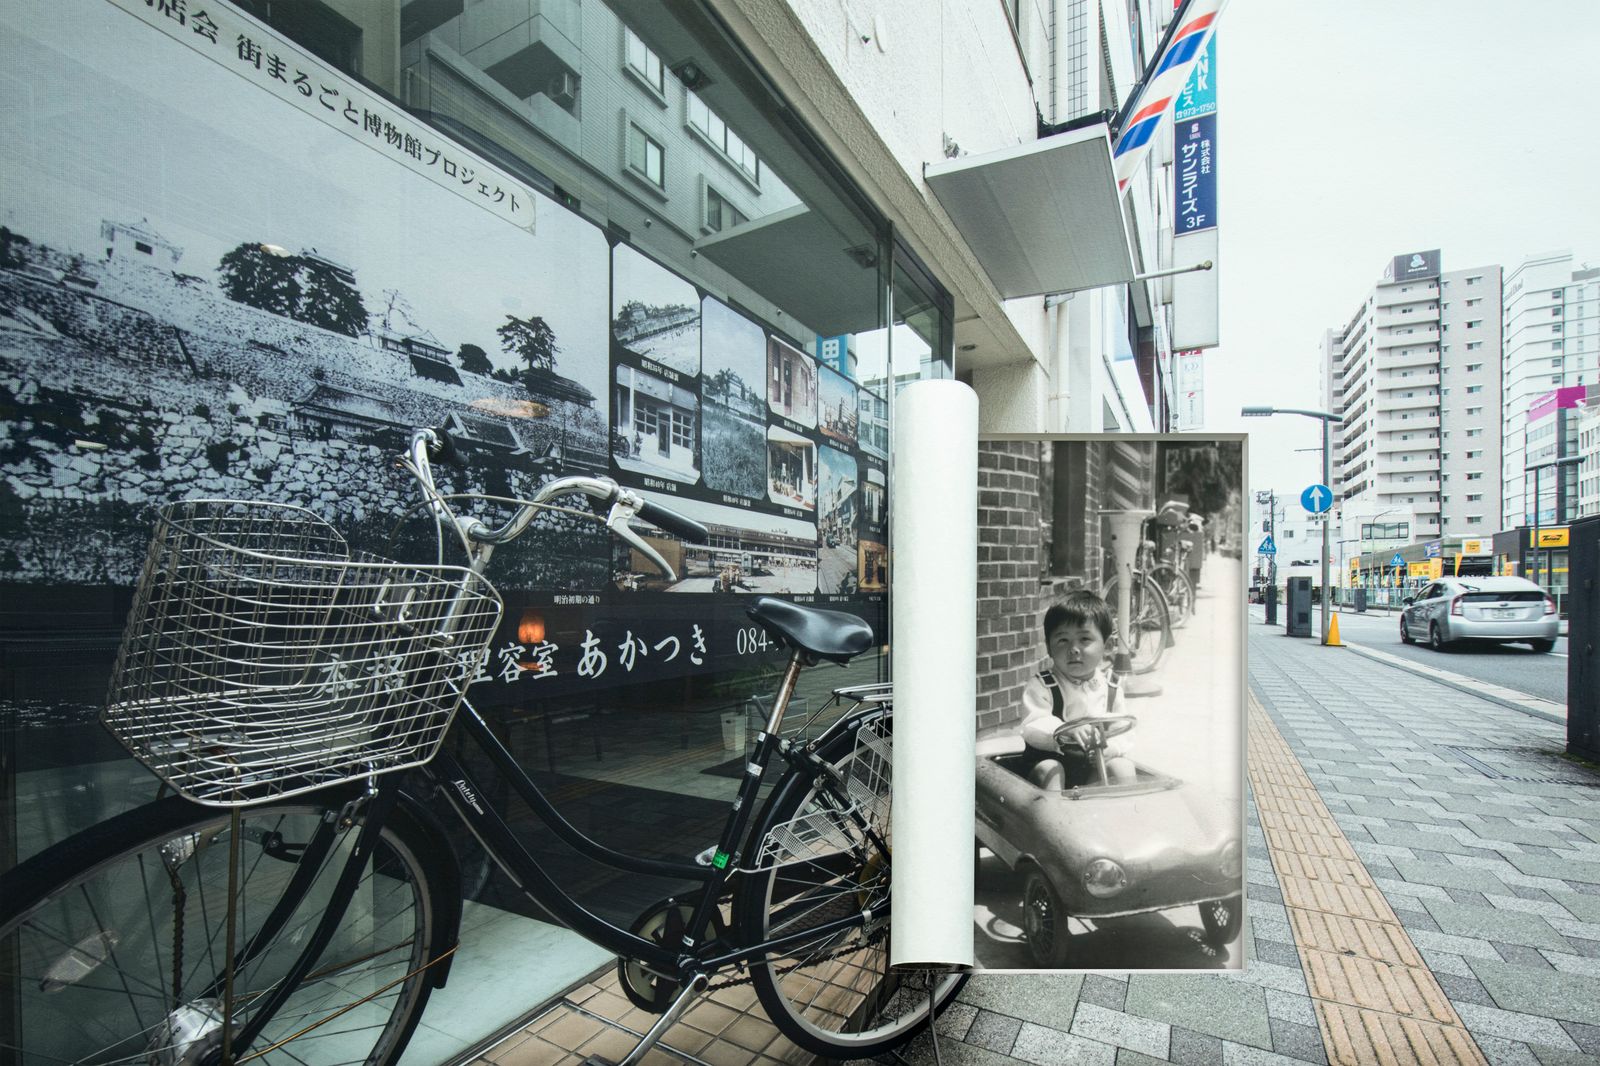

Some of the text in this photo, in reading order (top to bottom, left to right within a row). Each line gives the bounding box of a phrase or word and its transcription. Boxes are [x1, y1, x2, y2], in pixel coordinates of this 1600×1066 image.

[142, 0, 520, 213] 店会 街まるごと博物館プロジェクト
[1183, 102, 1215, 118] 973-1750
[1200, 139, 1211, 175] 株式会社
[1181, 142, 1198, 216] サンライズ
[1186, 214, 1206, 229] 3F
[553, 595, 601, 605] 明治初期の通り
[456, 640, 560, 684] 理容室
[576, 624, 708, 680] あかつき
[736, 627, 779, 655] 084-
